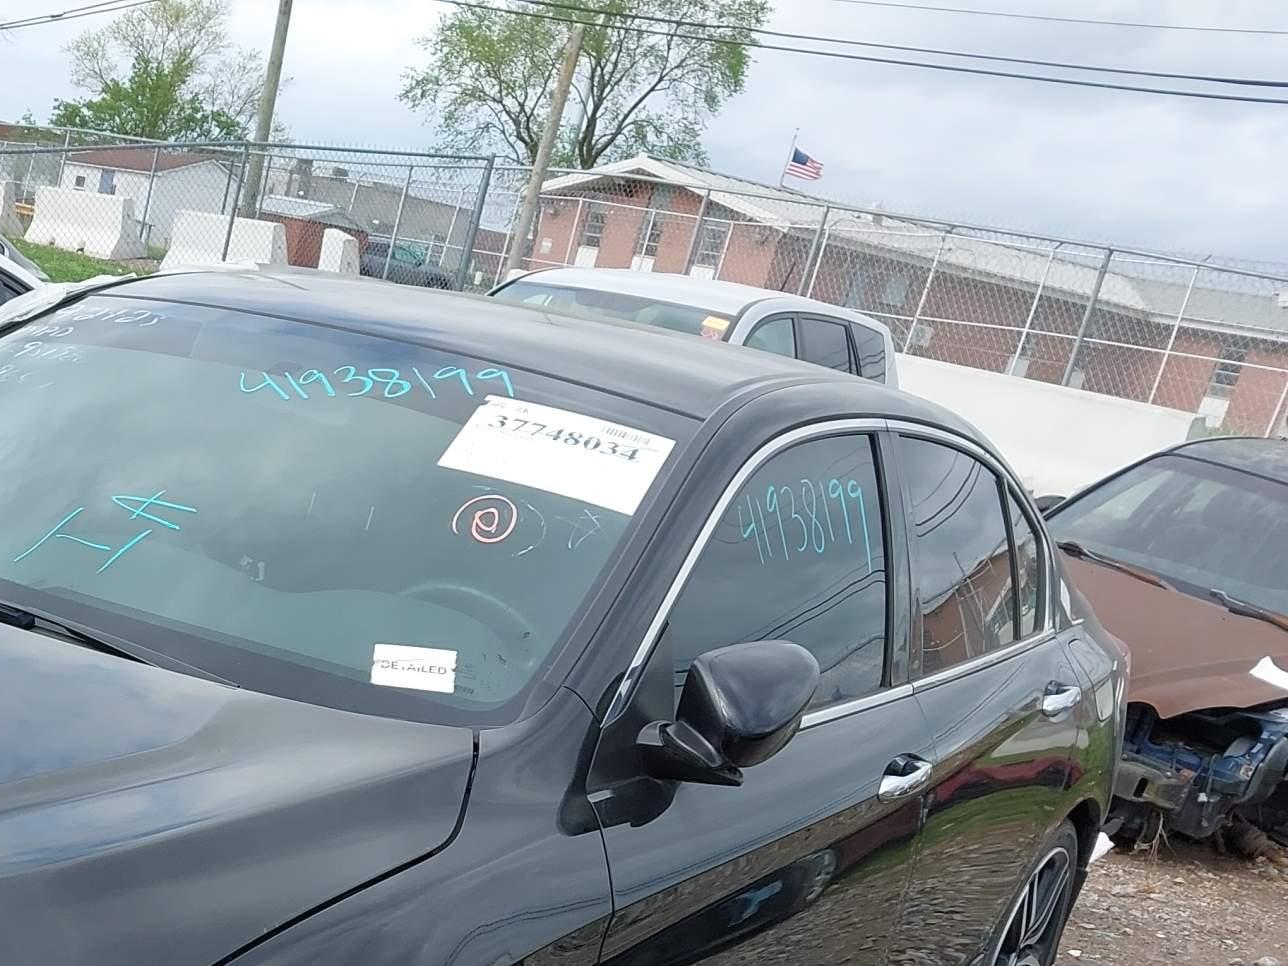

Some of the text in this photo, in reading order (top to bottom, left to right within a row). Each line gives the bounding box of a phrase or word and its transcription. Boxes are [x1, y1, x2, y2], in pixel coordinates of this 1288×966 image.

[239, 365, 515, 401] 41938199
[487, 414, 641, 463] 37748034
[737, 478, 873, 574] 41938199
